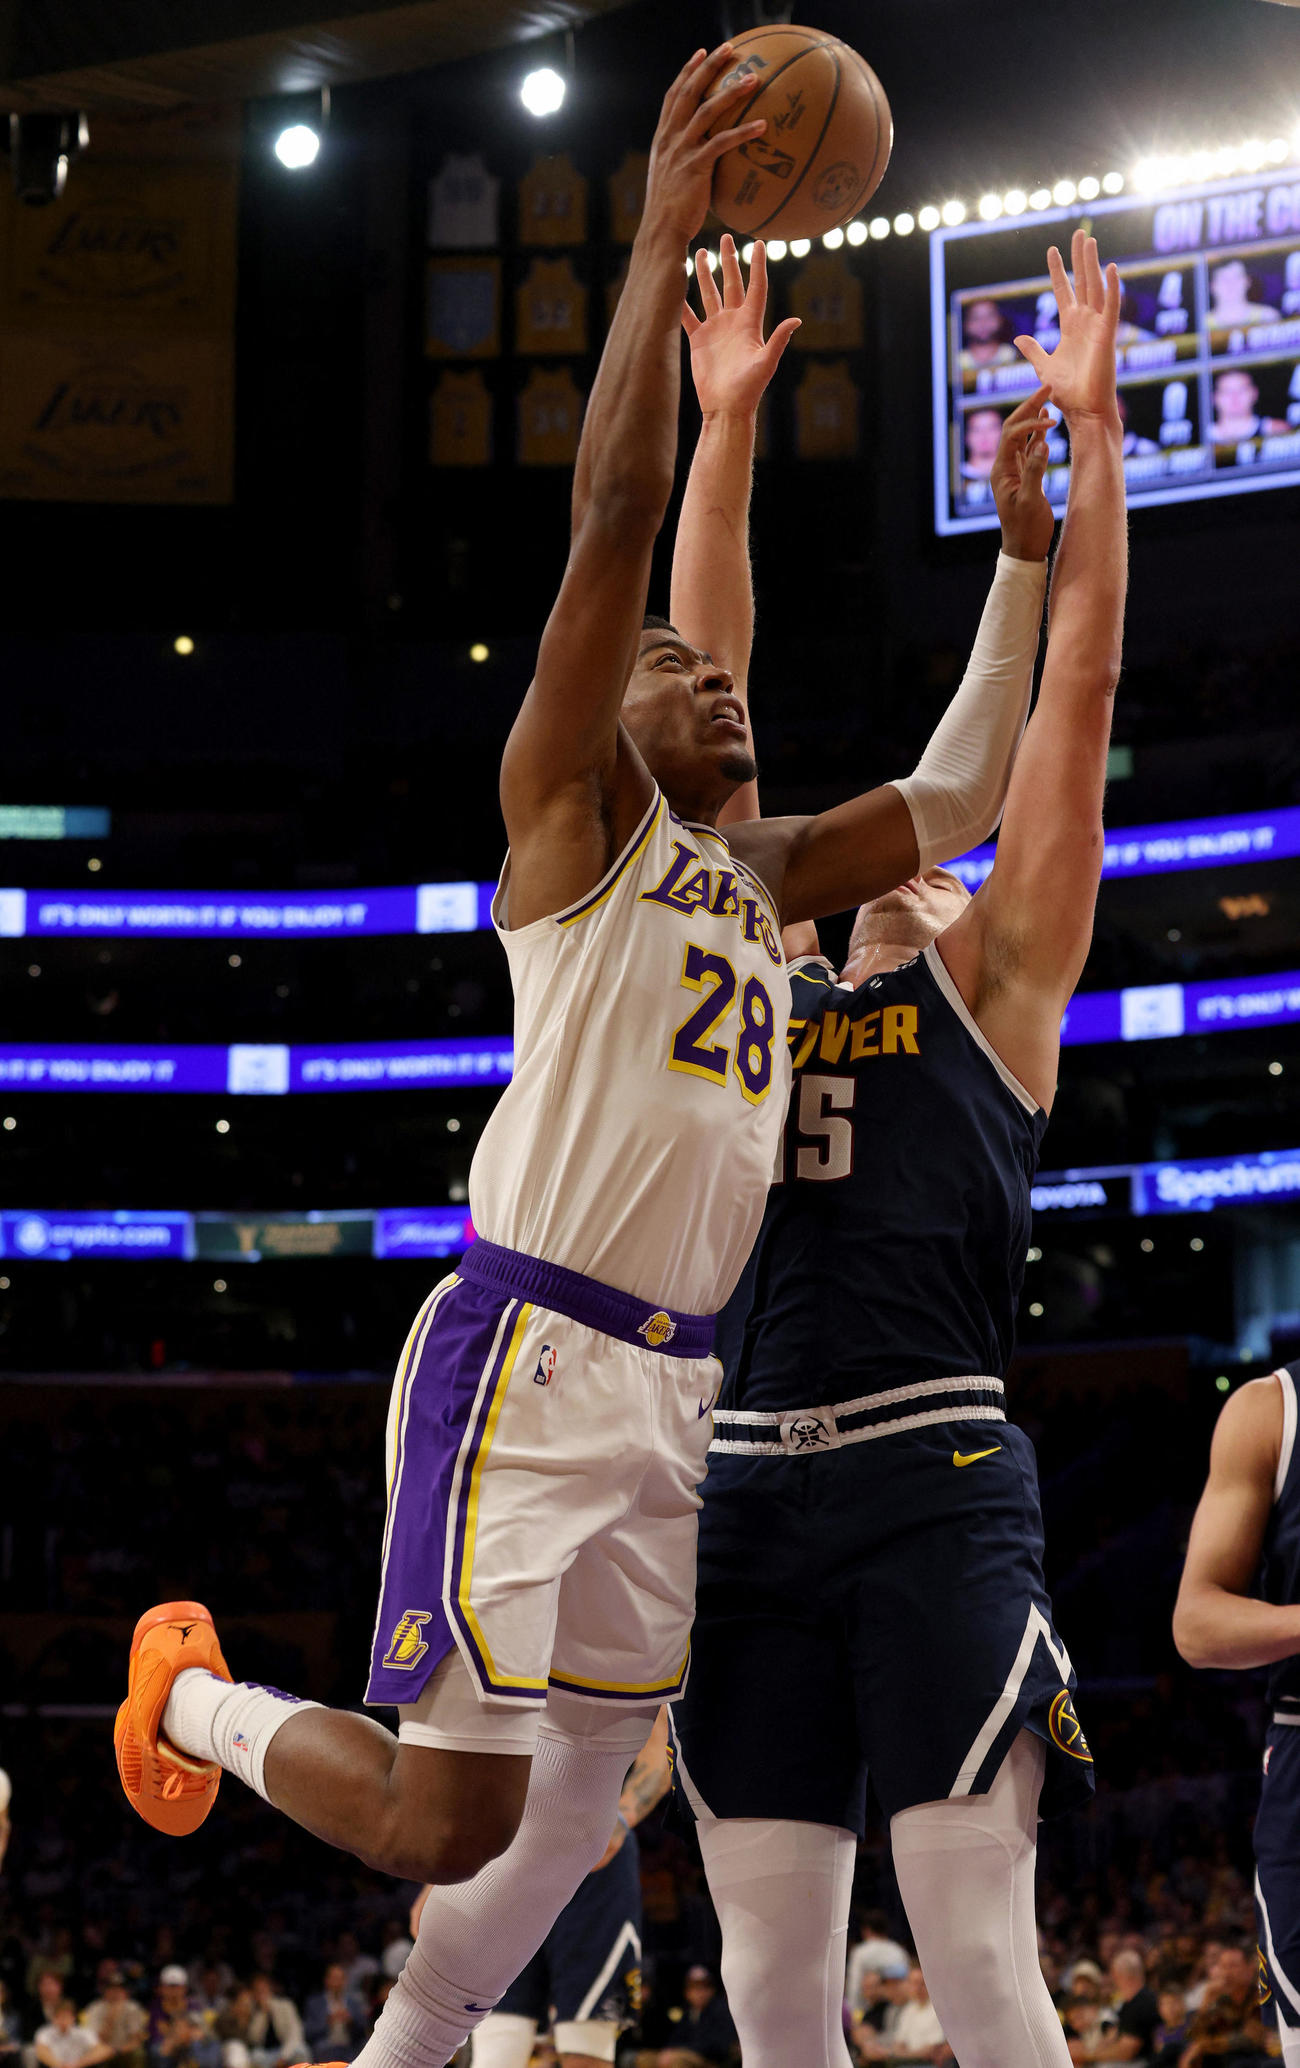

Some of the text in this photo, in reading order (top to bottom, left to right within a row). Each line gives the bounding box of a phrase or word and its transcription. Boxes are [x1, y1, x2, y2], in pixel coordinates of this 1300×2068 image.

[637, 839, 782, 967] LAKRS
[668, 941, 775, 1106] 28
[1031, 1182, 1107, 1211] OYOTA
